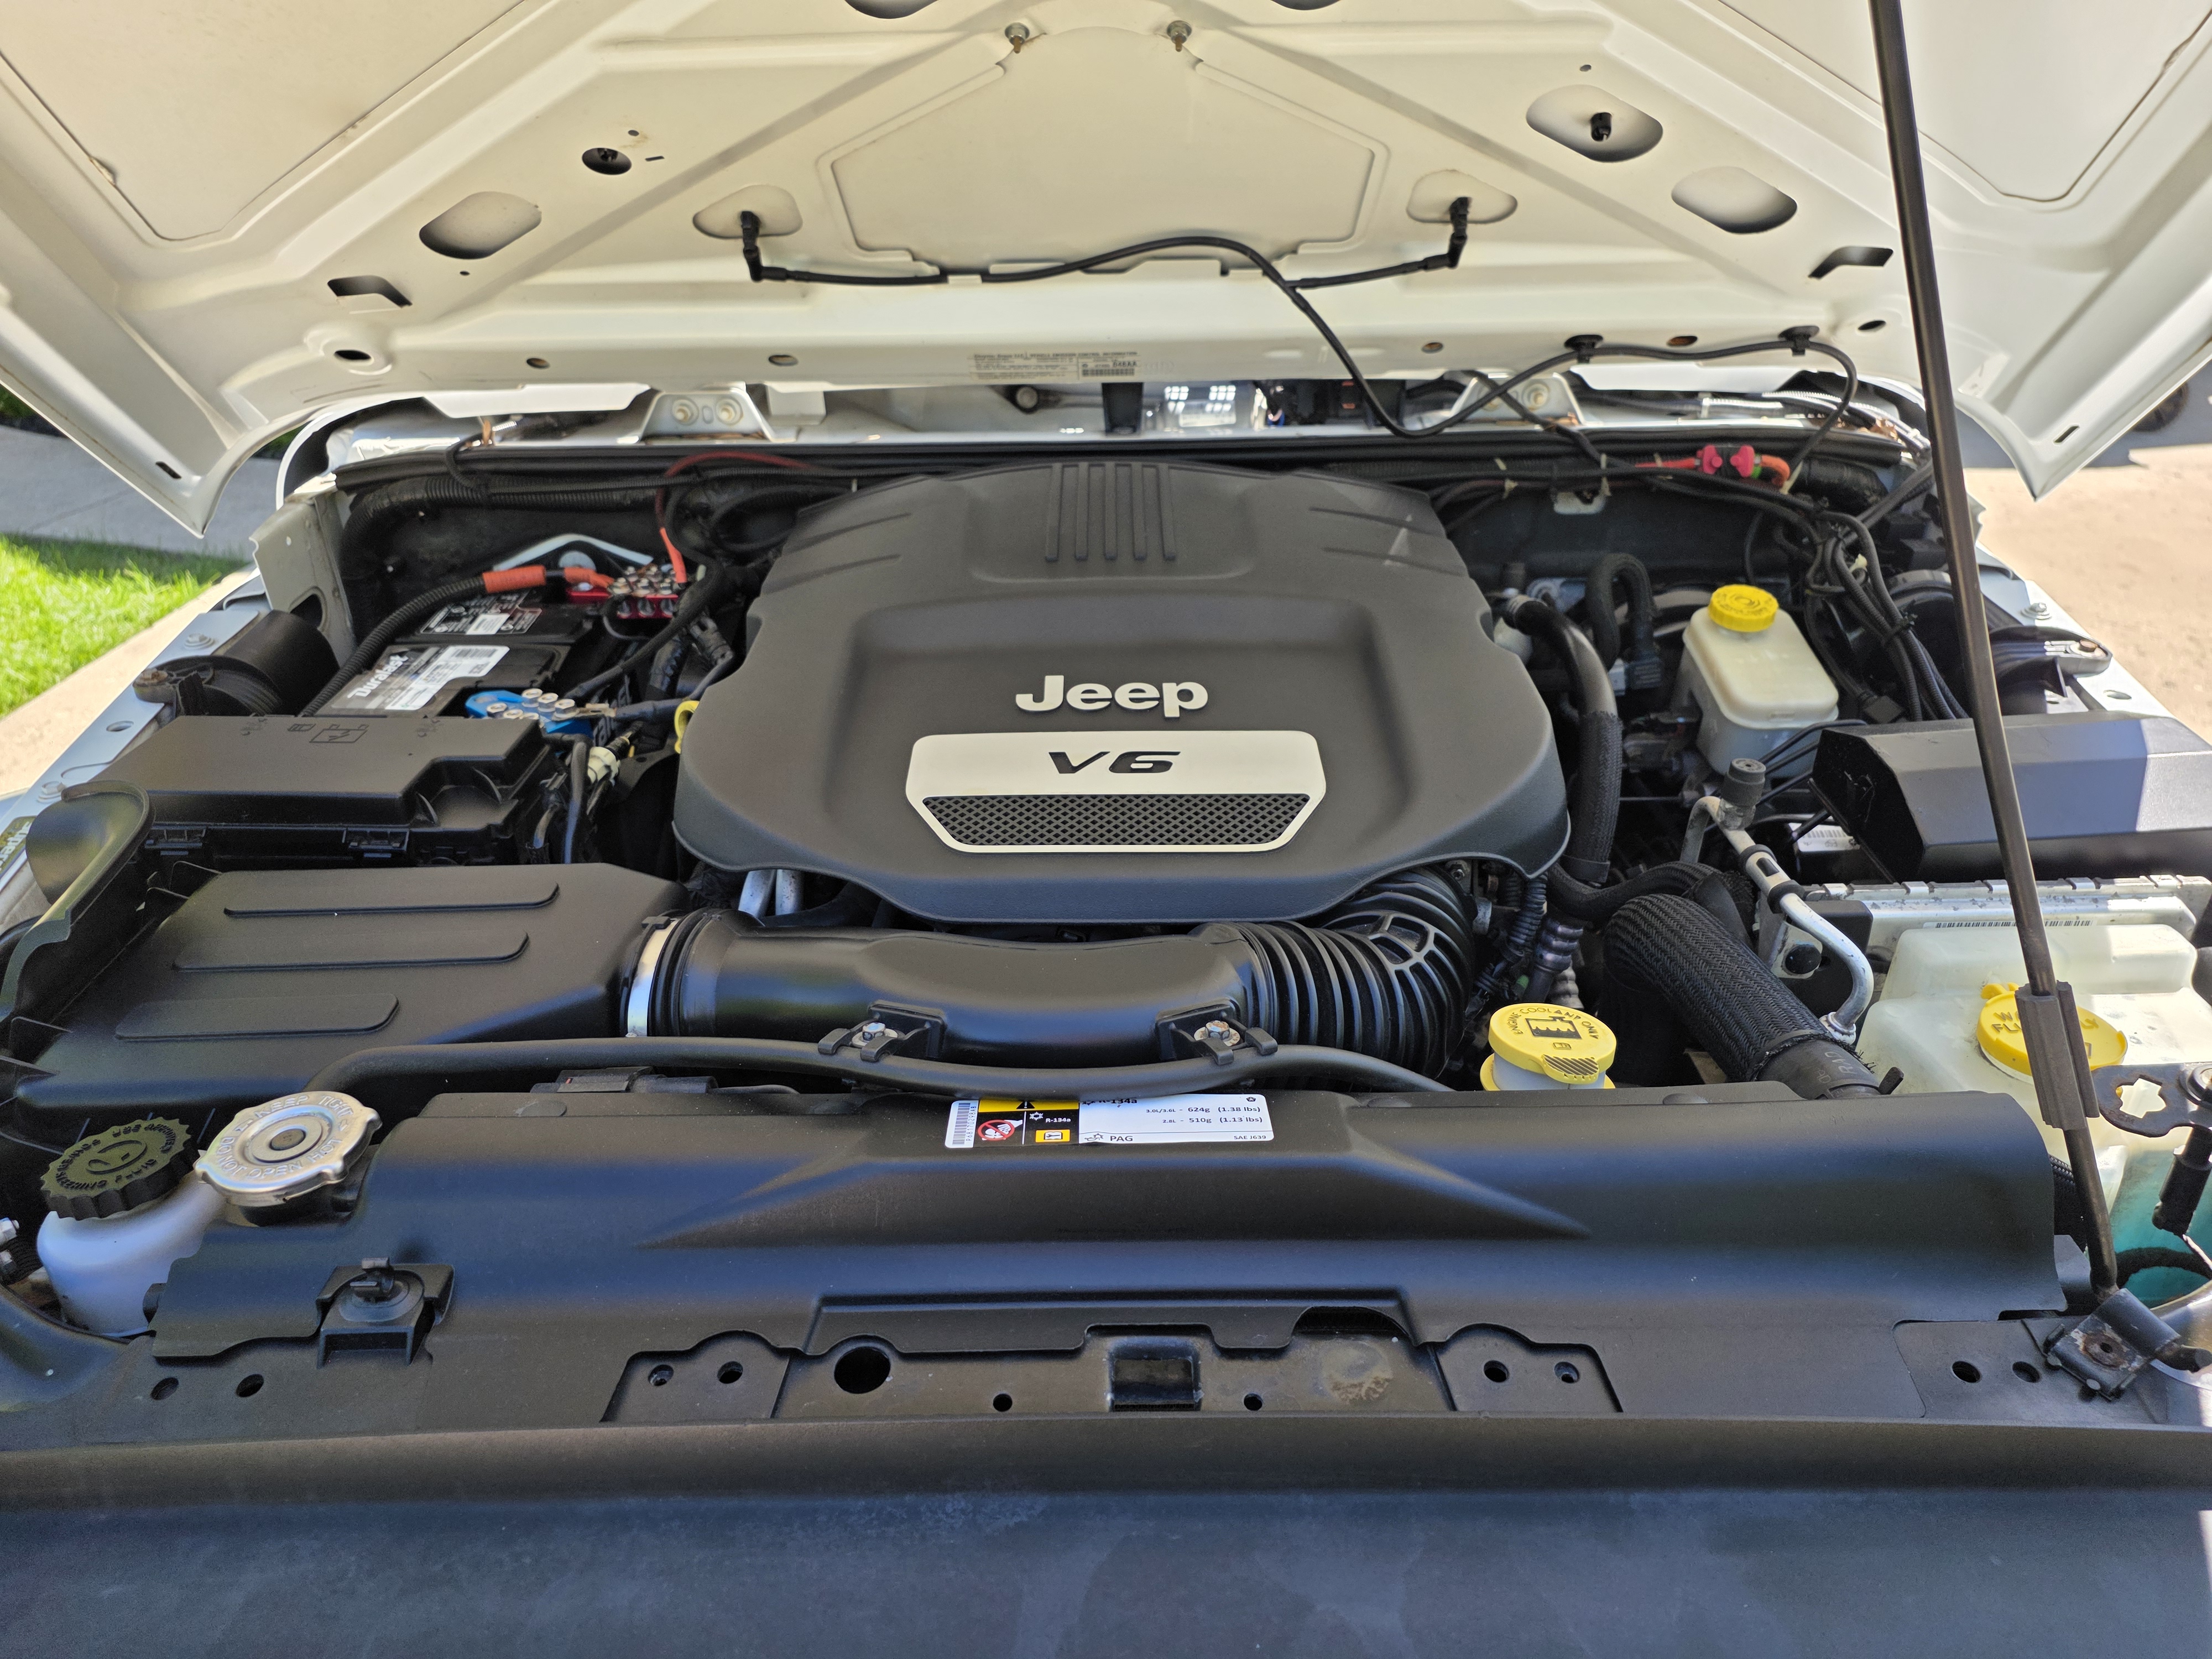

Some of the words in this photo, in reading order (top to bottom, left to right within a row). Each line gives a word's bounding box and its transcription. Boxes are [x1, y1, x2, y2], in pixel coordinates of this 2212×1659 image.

[347, 654, 409, 698] Duralast
[1016, 675, 1208, 718] Jeep
[1048, 751, 1181, 774] V6
[1507, 1012, 1524, 1035] ENGINE
[1520, 1007, 1582, 1019] COOLANT
[1582, 1021, 1599, 1040] ONLY
[255, 1095, 309, 1118] KEEP
[318, 1095, 354, 1117] TIGHT
[216, 1136, 235, 1155] DO
[306, 1137, 343, 1162] HOT
[216, 1155, 248, 1176] NOT
[247, 1164, 302, 1179] OPEN
